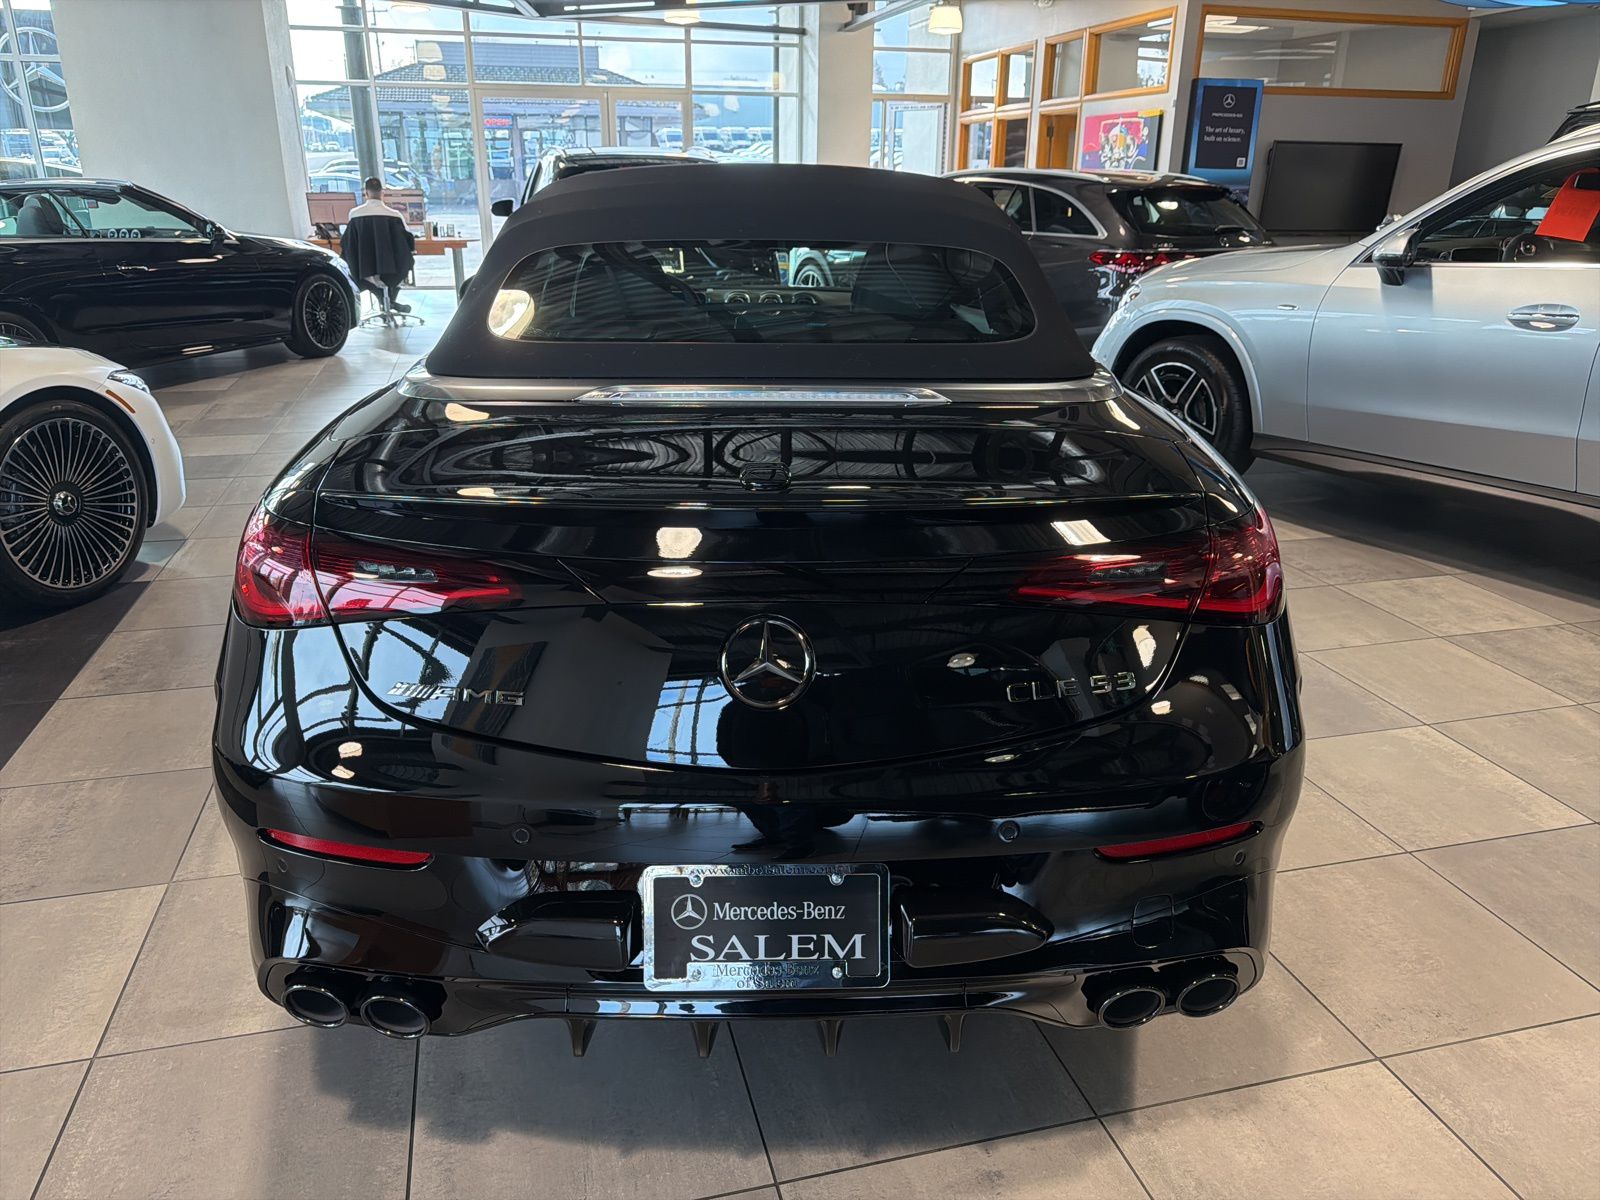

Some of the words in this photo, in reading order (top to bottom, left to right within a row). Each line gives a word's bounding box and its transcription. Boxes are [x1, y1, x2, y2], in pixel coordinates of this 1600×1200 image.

[429, 684, 525, 706] AMG
[1006, 678, 1080, 702] CLE
[1089, 671, 1136, 694] 53
[713, 901, 846, 921] Mercedes-Benz
[689, 933, 867, 962] SALEM
[736, 976, 751, 989] of
